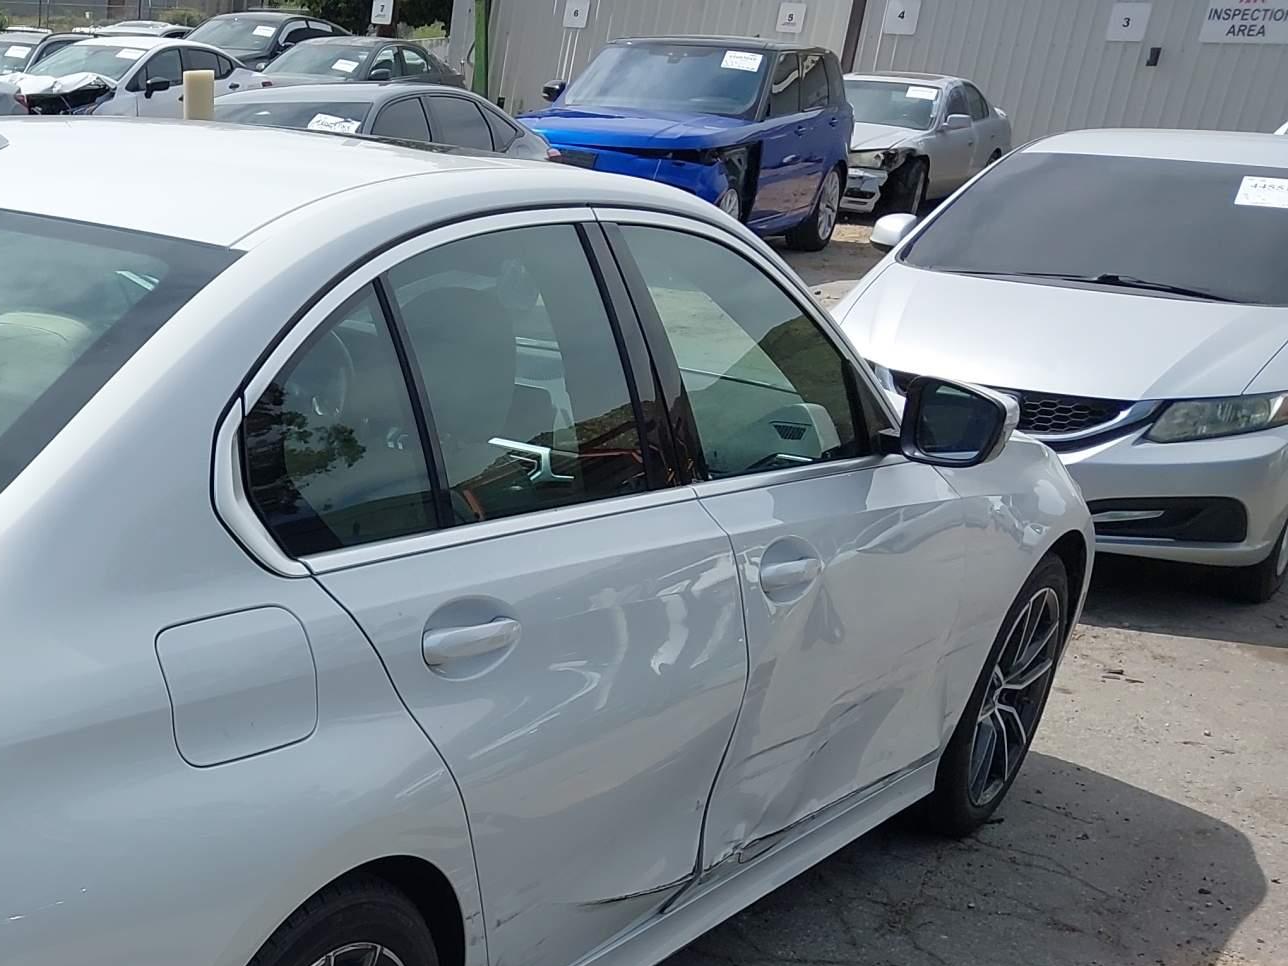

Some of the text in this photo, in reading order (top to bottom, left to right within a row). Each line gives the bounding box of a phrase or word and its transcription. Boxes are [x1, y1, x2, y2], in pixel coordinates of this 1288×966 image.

[379, 4, 385, 13] 7
[573, 9, 579, 17] 6
[898, 10, 905, 20] 4
[1122, 17, 1131, 28] 3
[1225, 24, 1266, 37] AREA
